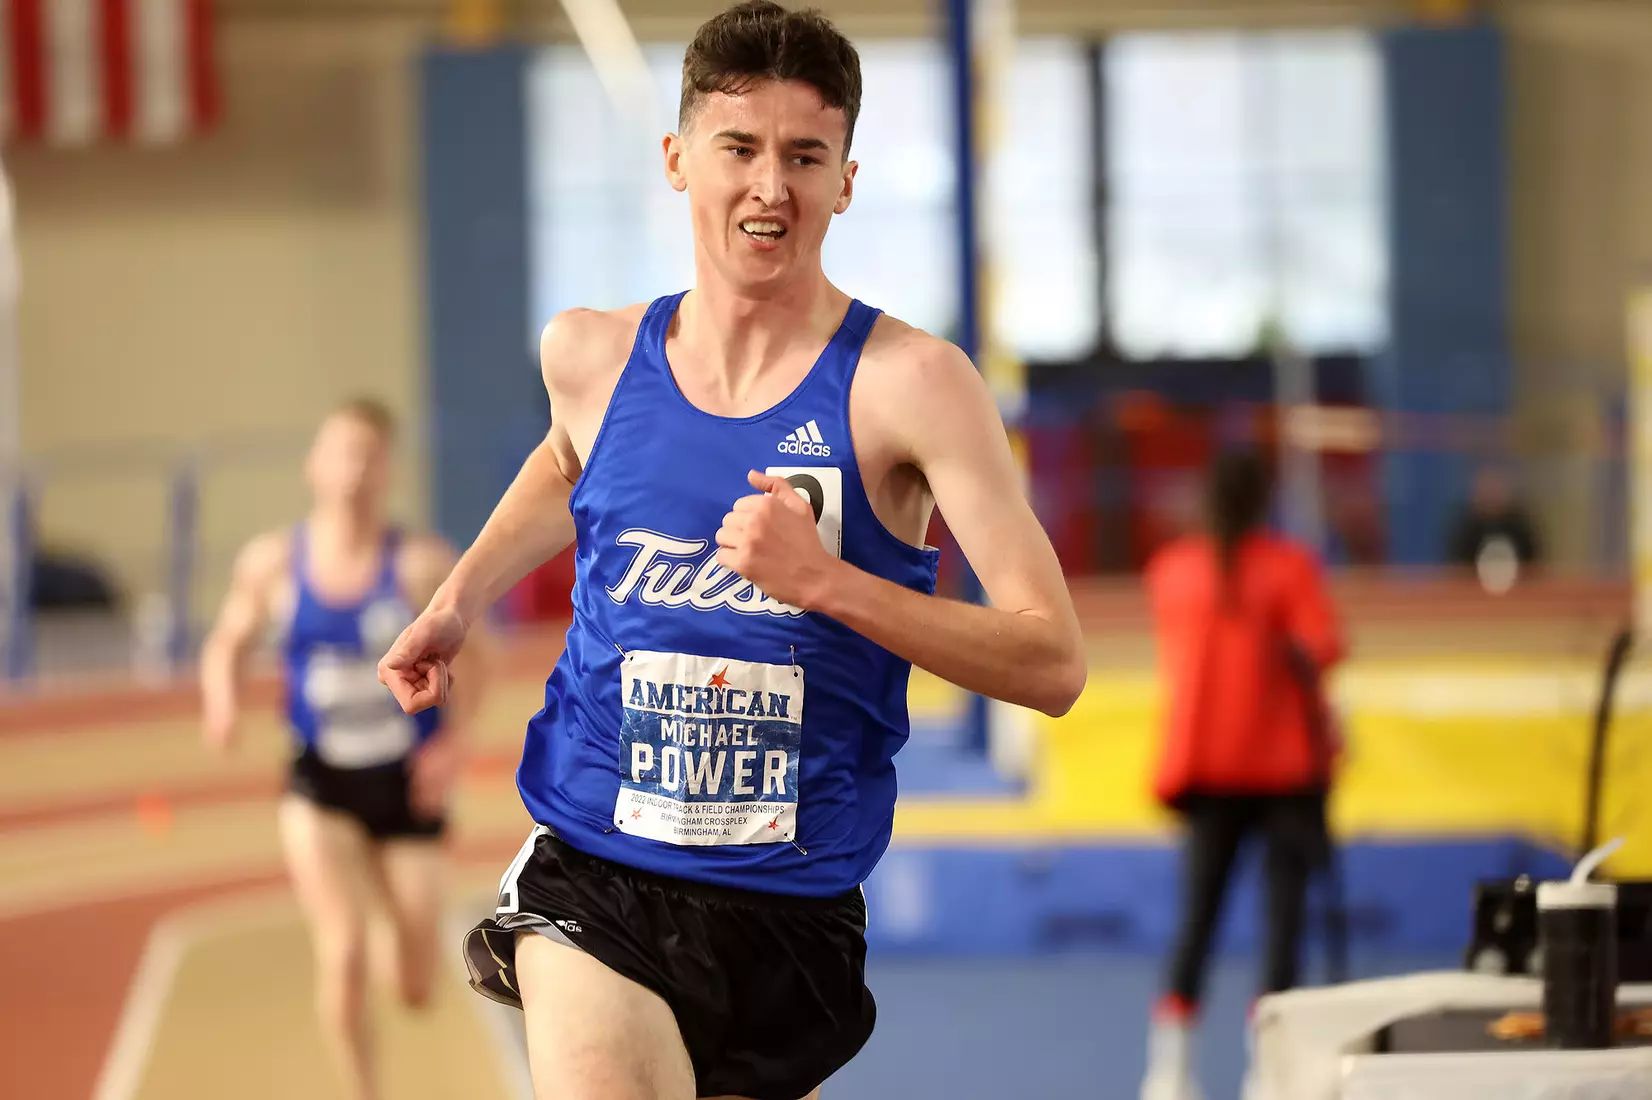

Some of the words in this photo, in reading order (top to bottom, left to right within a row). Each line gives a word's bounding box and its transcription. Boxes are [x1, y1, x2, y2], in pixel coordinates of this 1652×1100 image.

[777, 440, 831, 457] adidas
[629, 678, 790, 718] AMERICAN
[661, 719, 759, 747] MICHAEL
[632, 743, 787, 795] POWER
[631, 793, 646, 804] 2022
[694, 805, 700, 814] &
[702, 805, 723, 814] FIELD
[725, 804, 785, 814] CHAMPIONSHIPS
[704, 817, 748, 825] CROSSPLEX
[722, 828, 731, 836] AL
